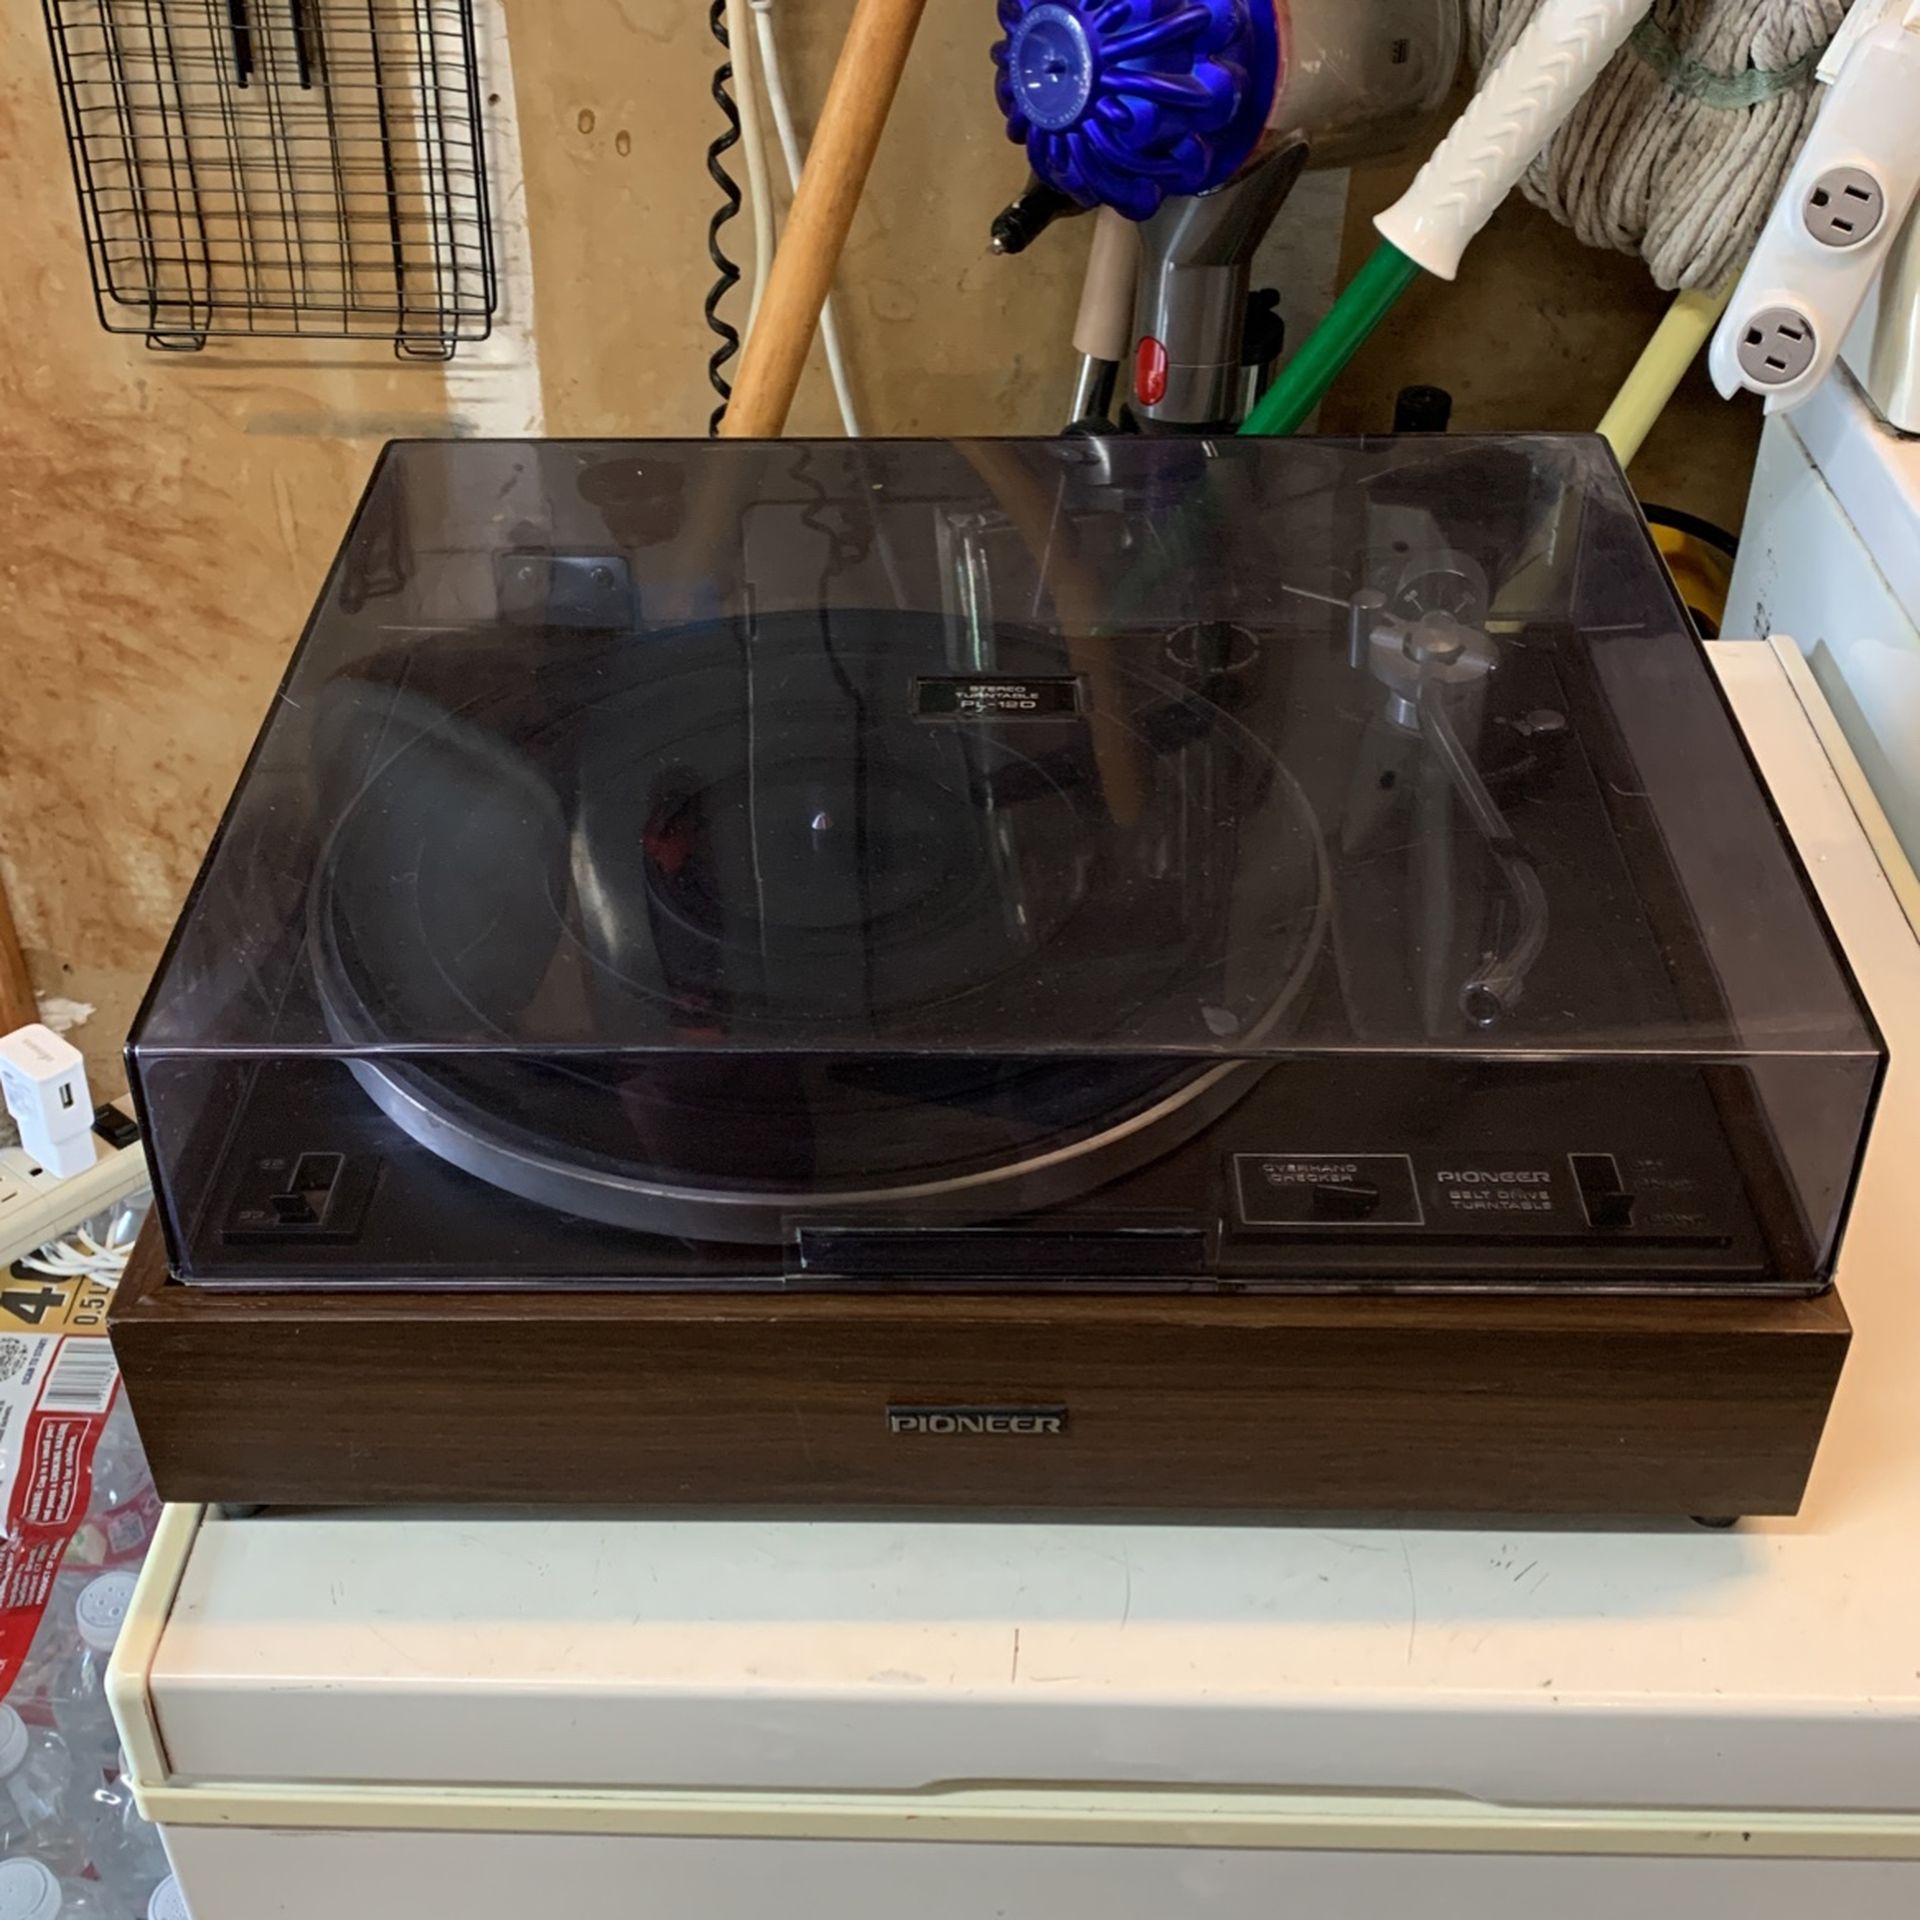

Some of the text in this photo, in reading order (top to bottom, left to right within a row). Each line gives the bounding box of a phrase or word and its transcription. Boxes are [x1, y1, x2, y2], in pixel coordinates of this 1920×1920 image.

[968, 685, 1027, 693] STEREO
[955, 692, 1040, 700] TURNTABLE
[1436, 1170, 1552, 1183] PIONEER
[1449, 1190, 1550, 1200] BELT DRIVE
[1451, 1201, 1552, 1210] TURNTABLE
[890, 1414, 1061, 1433] PIONEER
